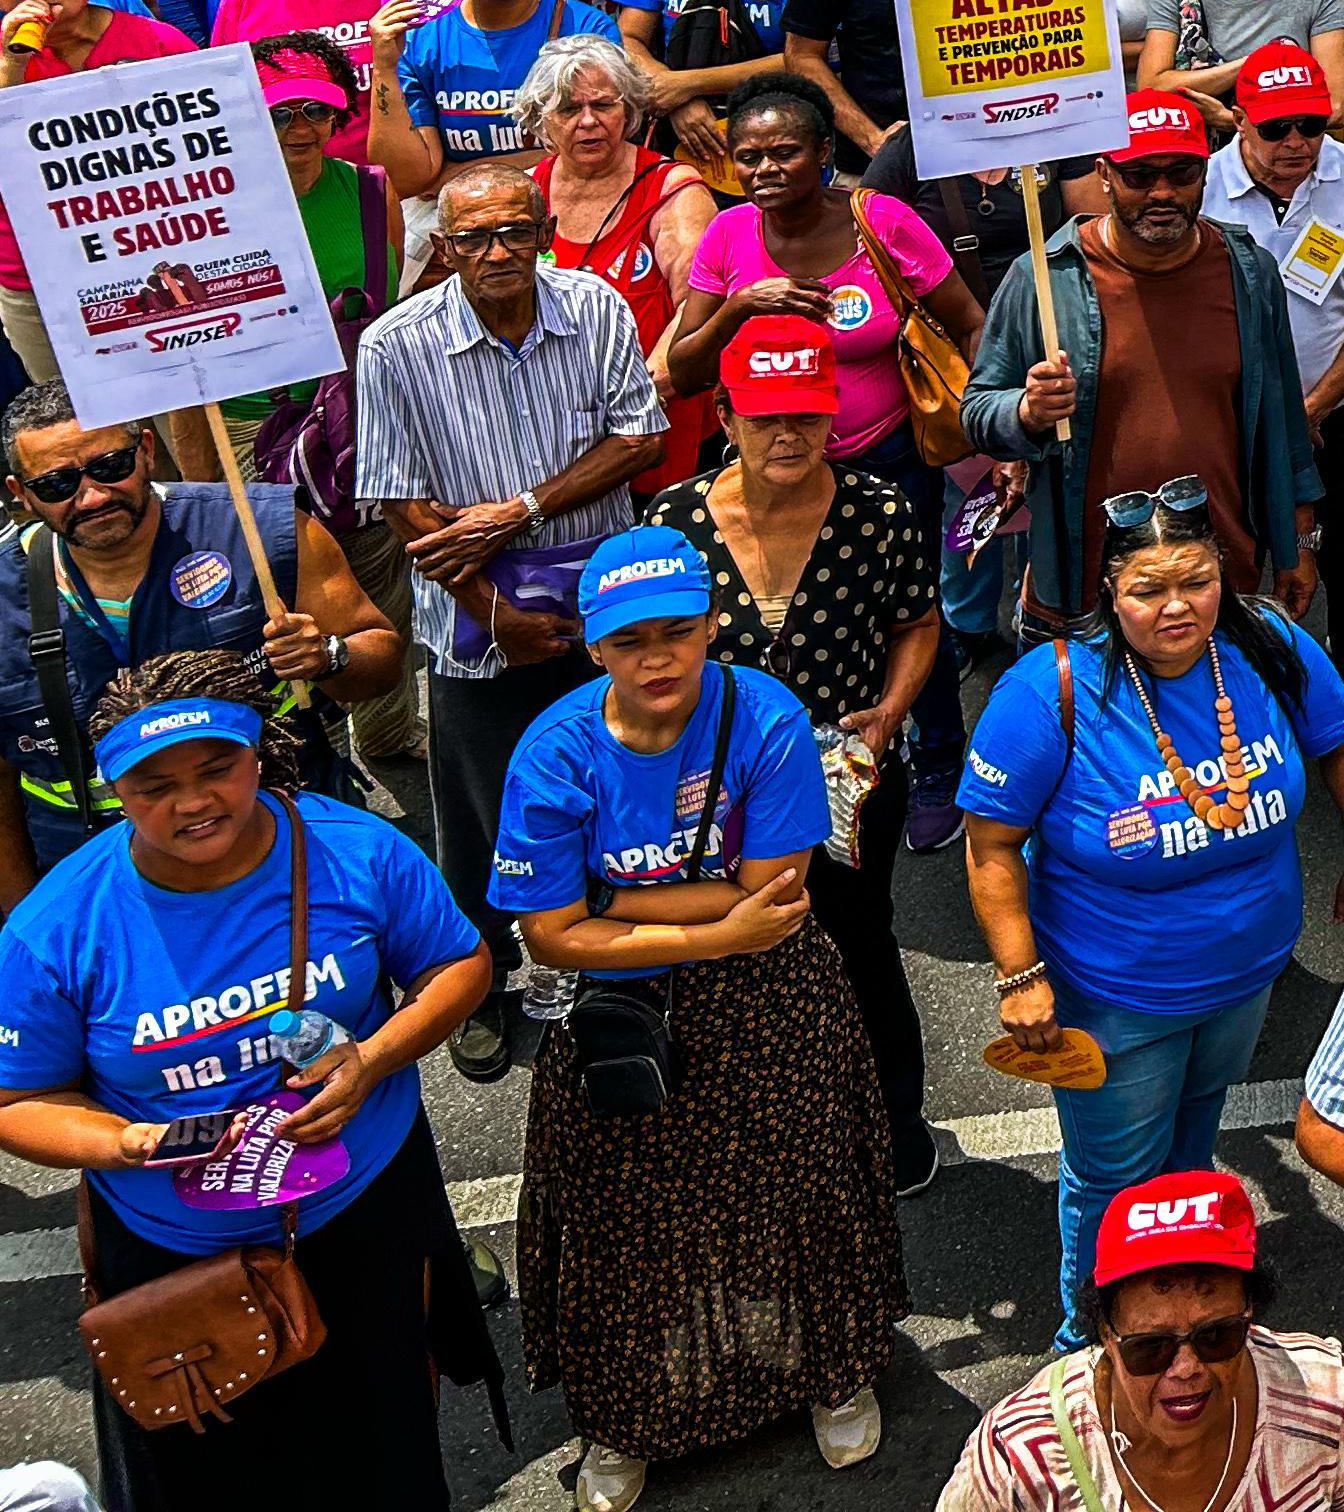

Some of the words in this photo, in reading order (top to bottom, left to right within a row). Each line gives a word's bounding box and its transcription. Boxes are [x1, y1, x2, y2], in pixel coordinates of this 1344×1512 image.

[934, 6, 1086, 45] TEMPERATURAS
[946, 45, 1085, 86] TEMPORAIS
[1259, 66, 1307, 86] CUT
[27, 87, 221, 152] CONDIÇÕES
[40, 139, 176, 191] DIGNAS
[183, 125, 233, 162] DE
[47, 165, 236, 230] TRABALHO
[80, 232, 107, 263] E
[112, 205, 231, 258] SAÚDE
[749, 349, 815, 372] CUT
[598, 557, 686, 593] APROFEM
[139, 709, 212, 737] APROFEM
[235, 1136, 271, 1171] LUTA
[229, 1173, 255, 1193] NA
[1127, 1192, 1220, 1231] CUT
